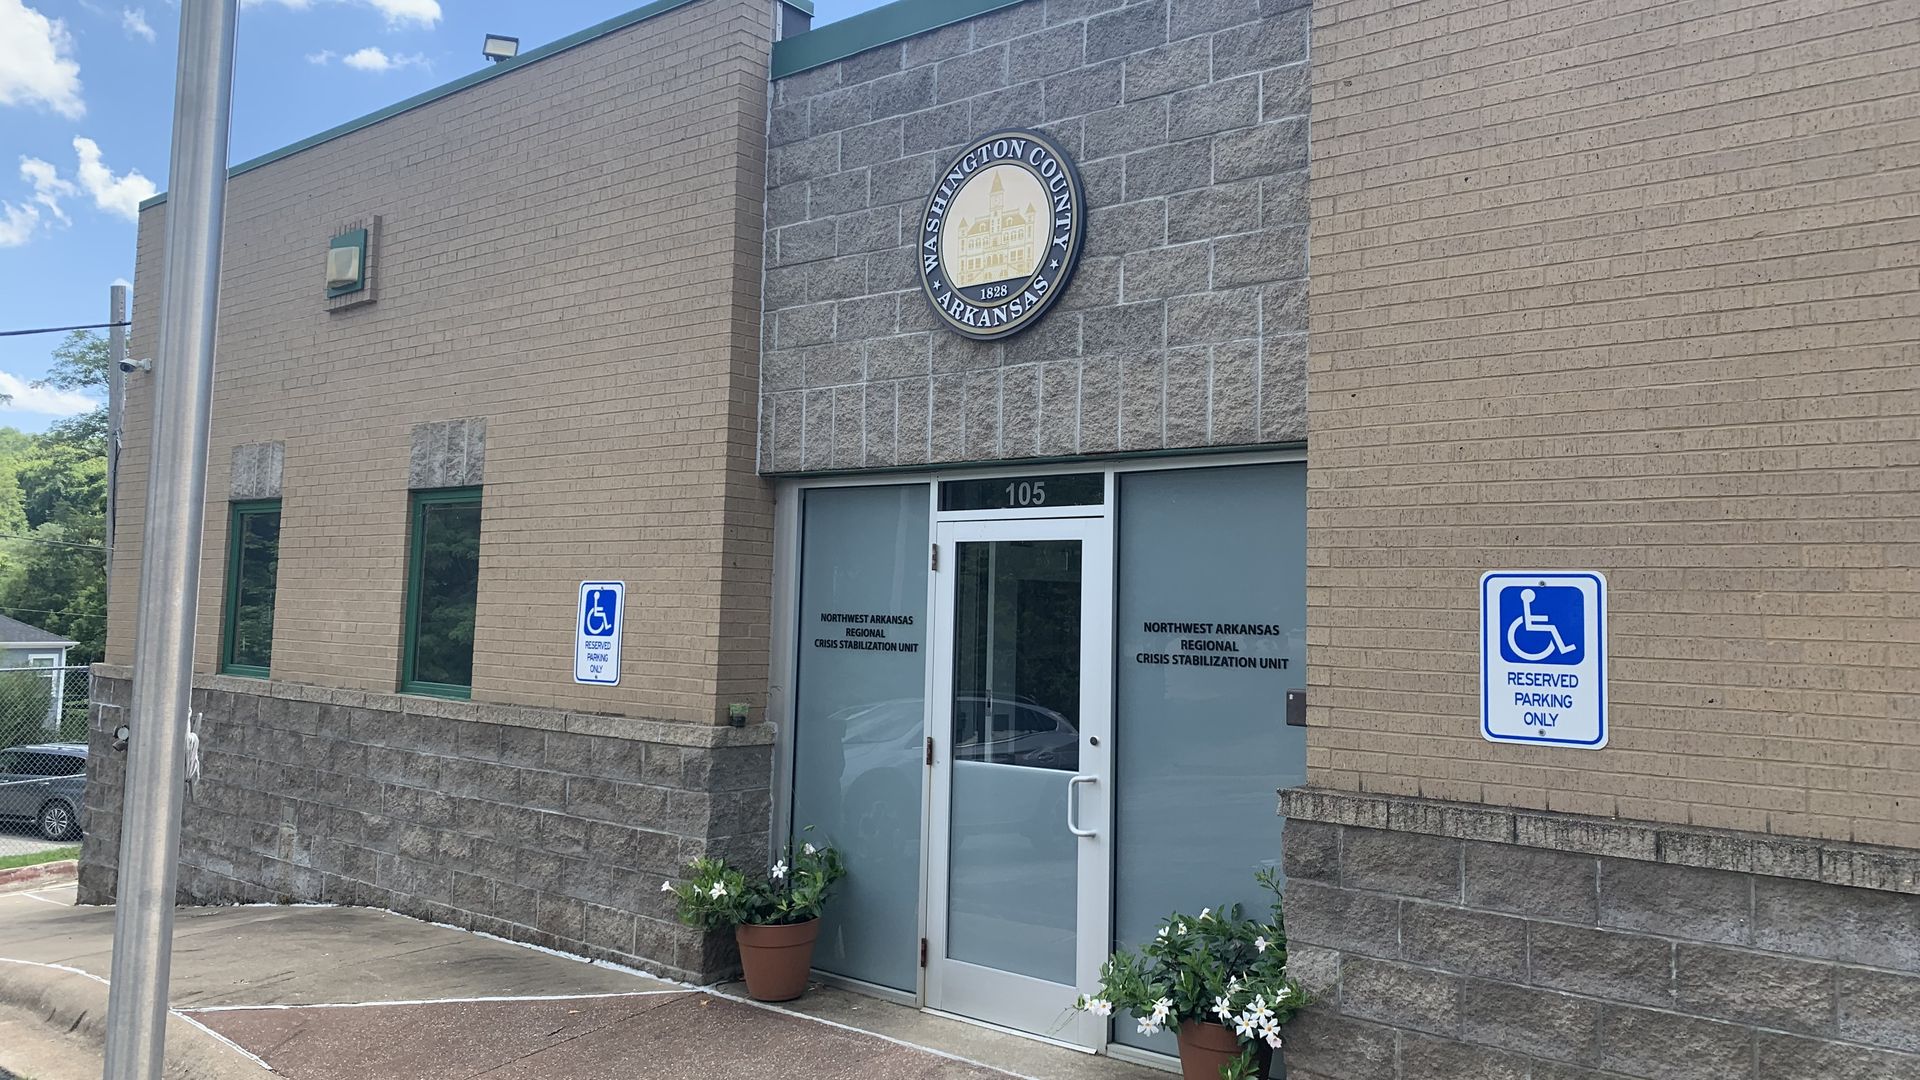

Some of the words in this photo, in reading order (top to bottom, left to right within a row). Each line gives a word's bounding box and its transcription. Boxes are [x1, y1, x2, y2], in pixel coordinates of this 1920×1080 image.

[924, 139, 1026, 275] WASHINGTON
[1029, 147, 1072, 251] COUNTY
[980, 285, 1008, 300] 1828
[937, 275, 1049, 327] ARKANSAS
[1005, 481, 1046, 506] 105
[820, 613, 869, 624] NORTHWEST
[870, 614, 914, 625] ARKANSAS
[845, 628, 886, 638] REGIONAL
[1143, 622, 1213, 634] NORTHWEST
[1215, 623, 1280, 636] ARKANSAS
[585, 641, 611, 650] RESERVED
[814, 638, 838, 649] CRISIS
[839, 639, 897, 652] STABILIZATION
[898, 642, 919, 653] UNIT
[1180, 639, 1240, 652] REGIONAL
[587, 652, 609, 662] PARKING
[1136, 653, 1170, 665] CRISIS
[1172, 654, 1257, 669] STABILIZATION
[1259, 658, 1290, 670] UNIT
[590, 664, 603, 674] ONLY
[1507, 671, 1579, 688] RESERVED
[1514, 692, 1573, 708] PARKING
[1523, 711, 1559, 727] ONLY
